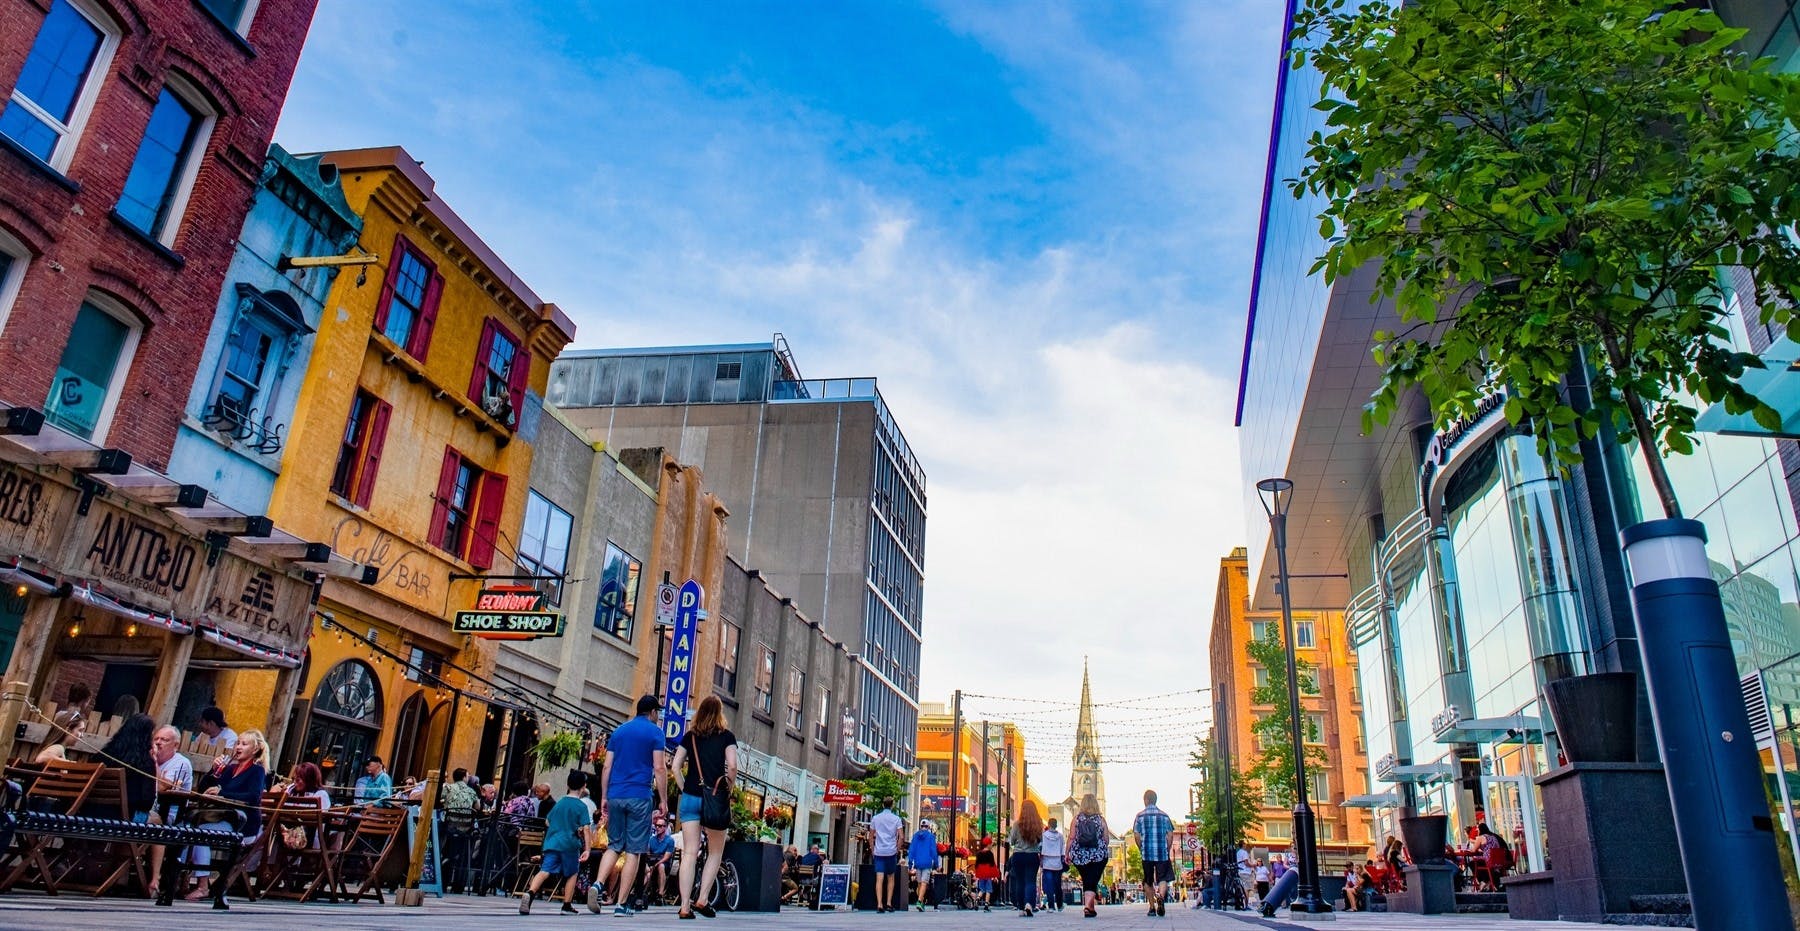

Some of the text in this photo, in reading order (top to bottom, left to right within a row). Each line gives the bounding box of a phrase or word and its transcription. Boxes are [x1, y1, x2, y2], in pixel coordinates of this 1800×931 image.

[86, 511, 196, 592] ANTOJO
[395, 563, 431, 599] BAR
[206, 597, 292, 637] AZTECA
[478, 593, 541, 611] ECONOMY
[460, 613, 553, 630] SHOE SHOP
[665, 591, 696, 739] DIAMOND
